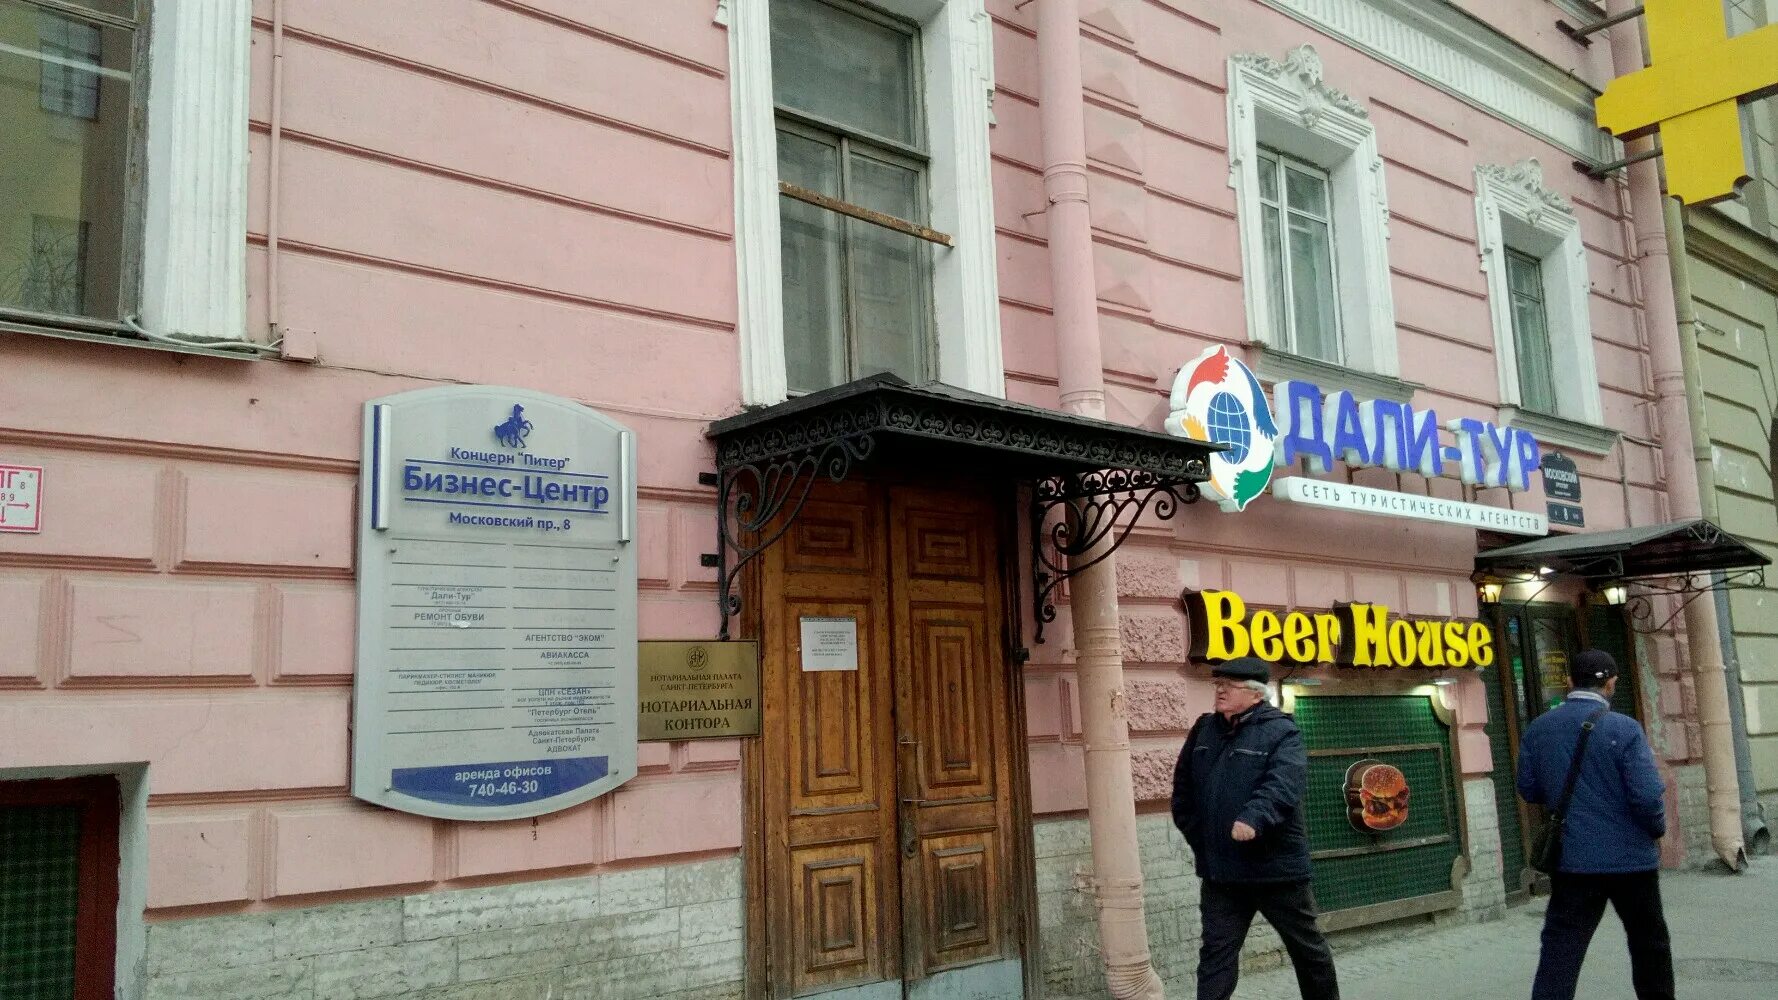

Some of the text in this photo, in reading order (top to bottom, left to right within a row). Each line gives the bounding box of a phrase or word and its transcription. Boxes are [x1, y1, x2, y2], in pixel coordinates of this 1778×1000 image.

[1284, 380, 1541, 492] ДАЛИ-ТУР
[450, 447, 515, 465] Концерн
[20, 481, 26, 489] 8
[404, 465, 609, 509] Бизнес-Центр
[1302, 484, 1540, 531] СЕТЬ ТУРИСТИЧЕСКИХ АГЕНТСТВ
[450, 511, 534, 528] Московский
[563, 519, 571, 531] 8
[414, 613, 485, 621] РЕМОНТ ОБУВИ
[1200, 590, 1493, 667] Beer House
[525, 634, 573, 642] АГЕНТСТВО
[540, 651, 590, 659] АВИАКАССА
[650, 674, 711, 682] НОТАРИАЛЬНАЯ
[640, 698, 752, 713] НОТАРИАЛЬНАЯ
[664, 717, 731, 731] КОНТОРА
[532, 735, 596, 744] Санкт-Петербурга
[547, 744, 582, 753] АДВОКАТ
[455, 766, 552, 782] аренда офисов
[469, 780, 538, 797] 740-46-30
